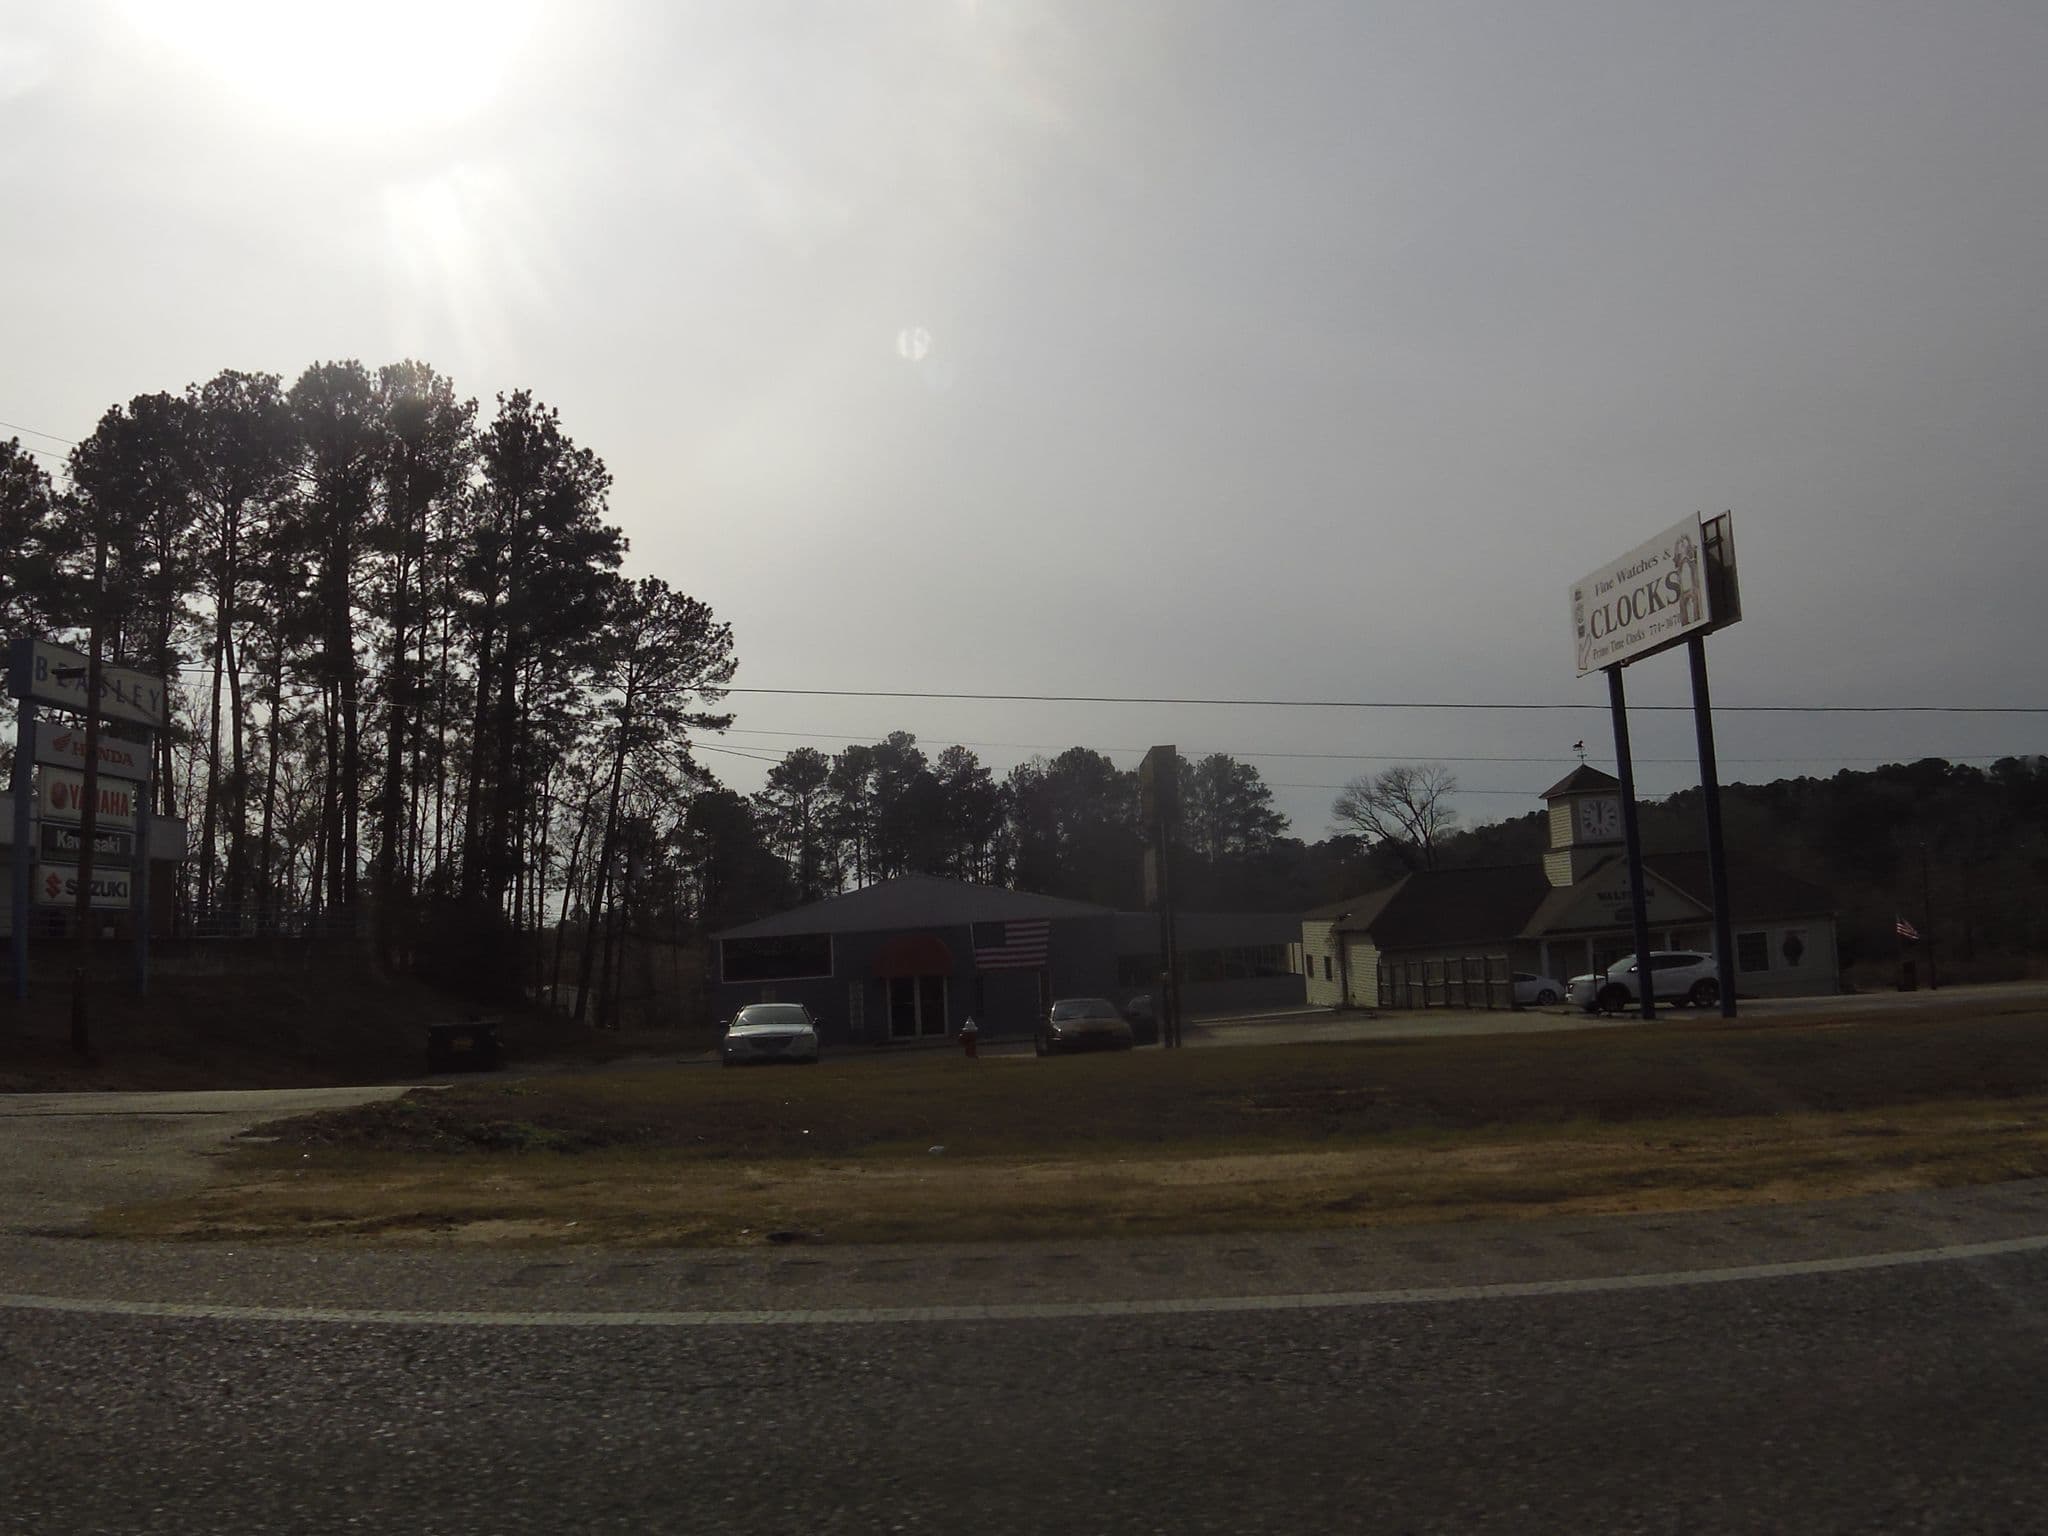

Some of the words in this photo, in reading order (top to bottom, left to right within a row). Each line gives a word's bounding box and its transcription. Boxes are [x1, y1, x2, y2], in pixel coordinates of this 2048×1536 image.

[1594, 579, 1614, 597] Fine
[1616, 556, 1659, 584] Watches
[1591, 570, 1682, 639] CLOCKS
[72, 742, 135, 768] HNDA
[70, 783, 129, 817] YAAHA
[56, 829, 121, 855] Kawsaki
[64, 878, 128, 898] SZUKI
